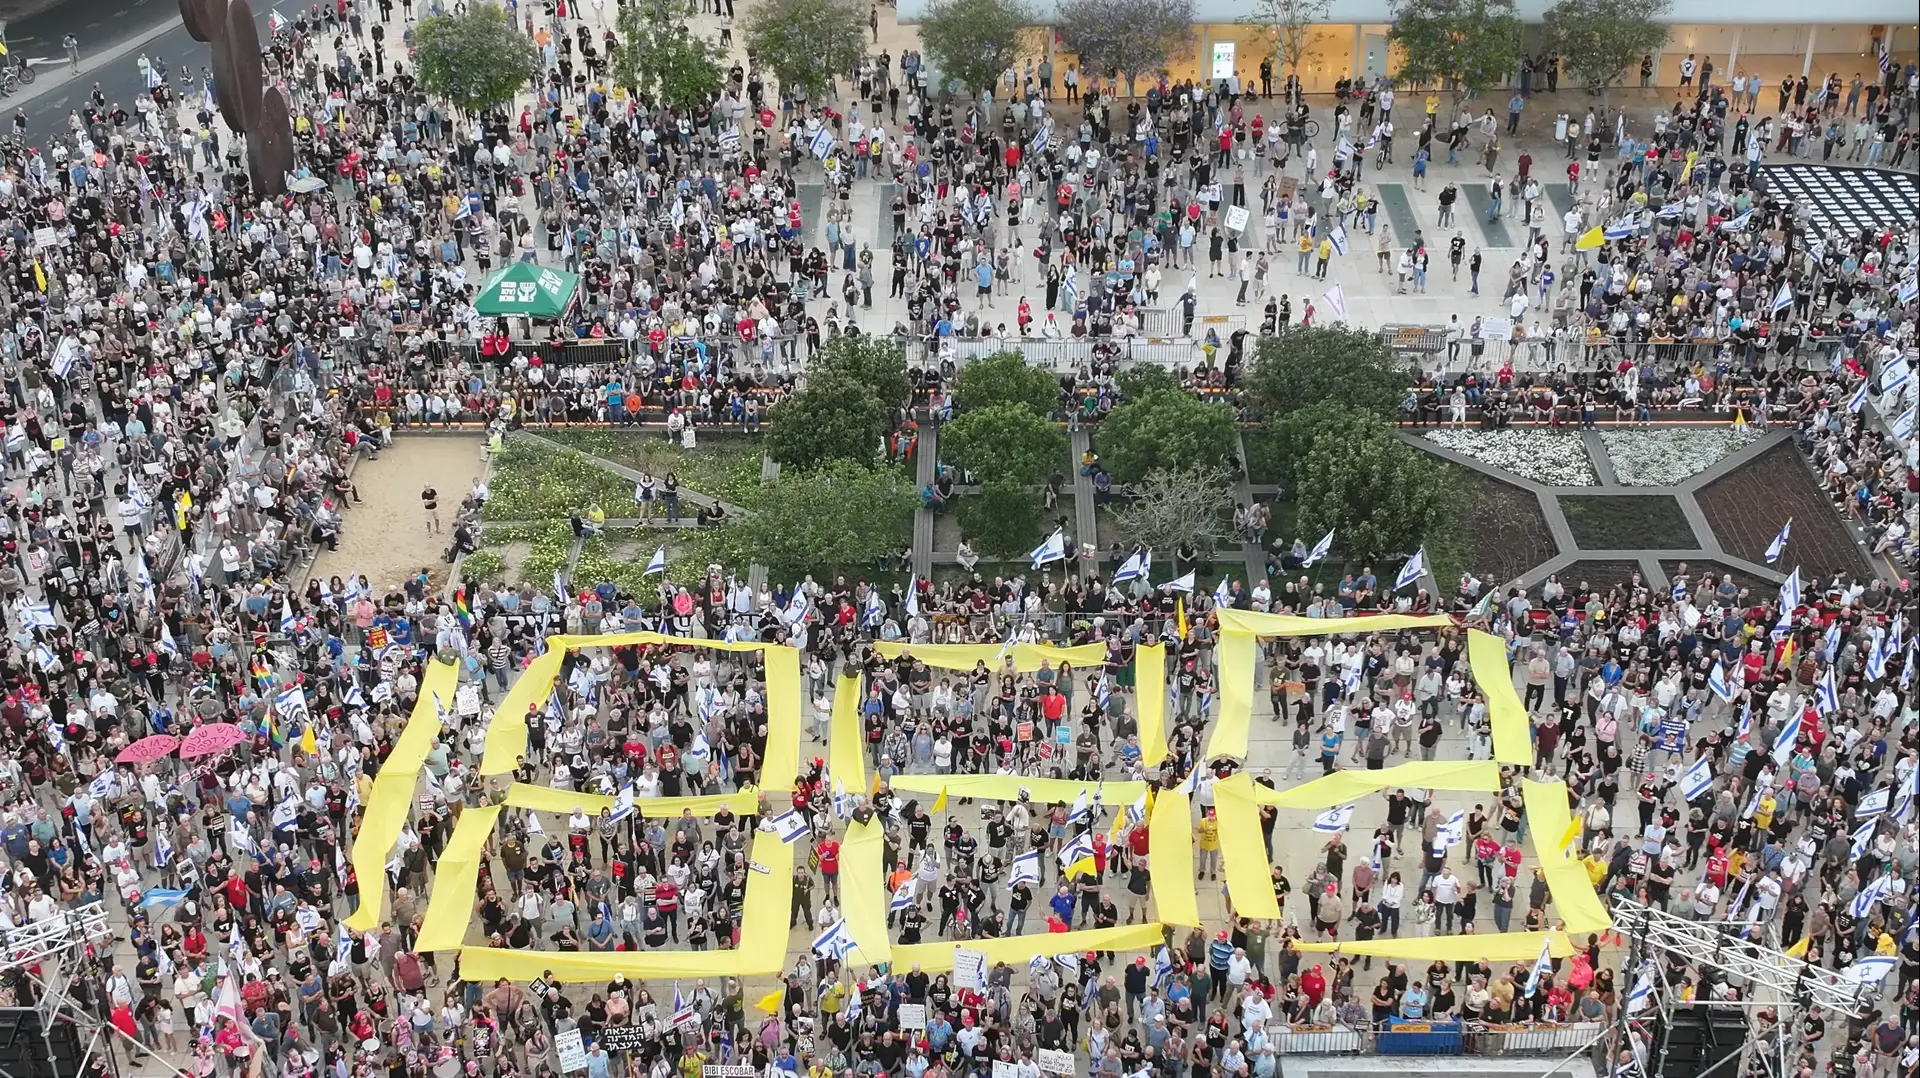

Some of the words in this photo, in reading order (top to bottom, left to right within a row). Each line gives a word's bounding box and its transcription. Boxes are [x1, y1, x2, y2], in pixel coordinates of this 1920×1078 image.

[606, 1033, 643, 1042] המדינה
[704, 1066, 719, 1075] BIBI
[720, 1066, 754, 1076] ESCOBAR
